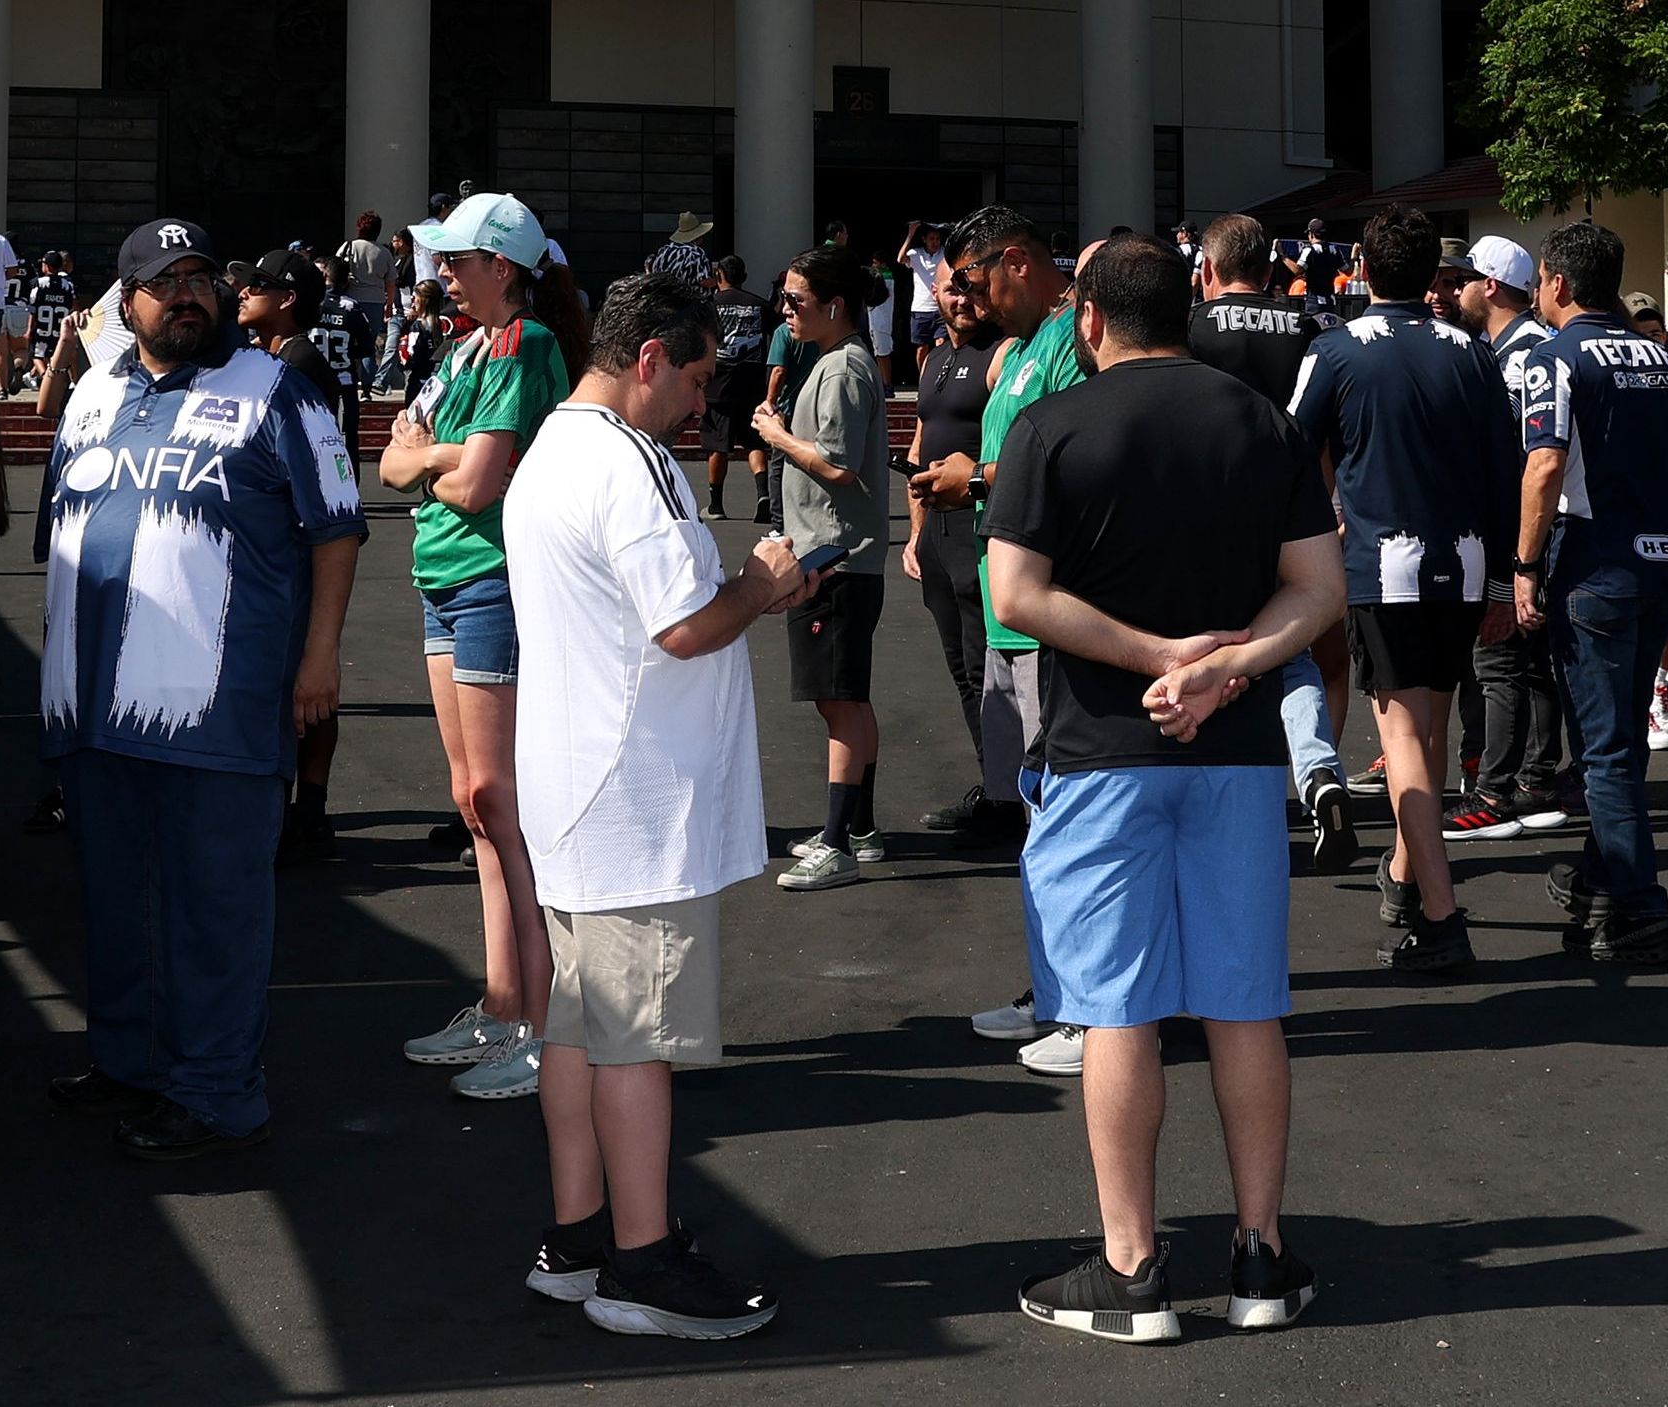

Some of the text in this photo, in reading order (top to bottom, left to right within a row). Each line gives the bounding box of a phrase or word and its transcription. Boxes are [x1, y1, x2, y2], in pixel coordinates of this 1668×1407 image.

[36, 305, 70, 337] 93
[320, 313, 344, 326] AMOS
[1207, 305, 1301, 335] TECATE
[187, 418, 238, 433] Monterrey
